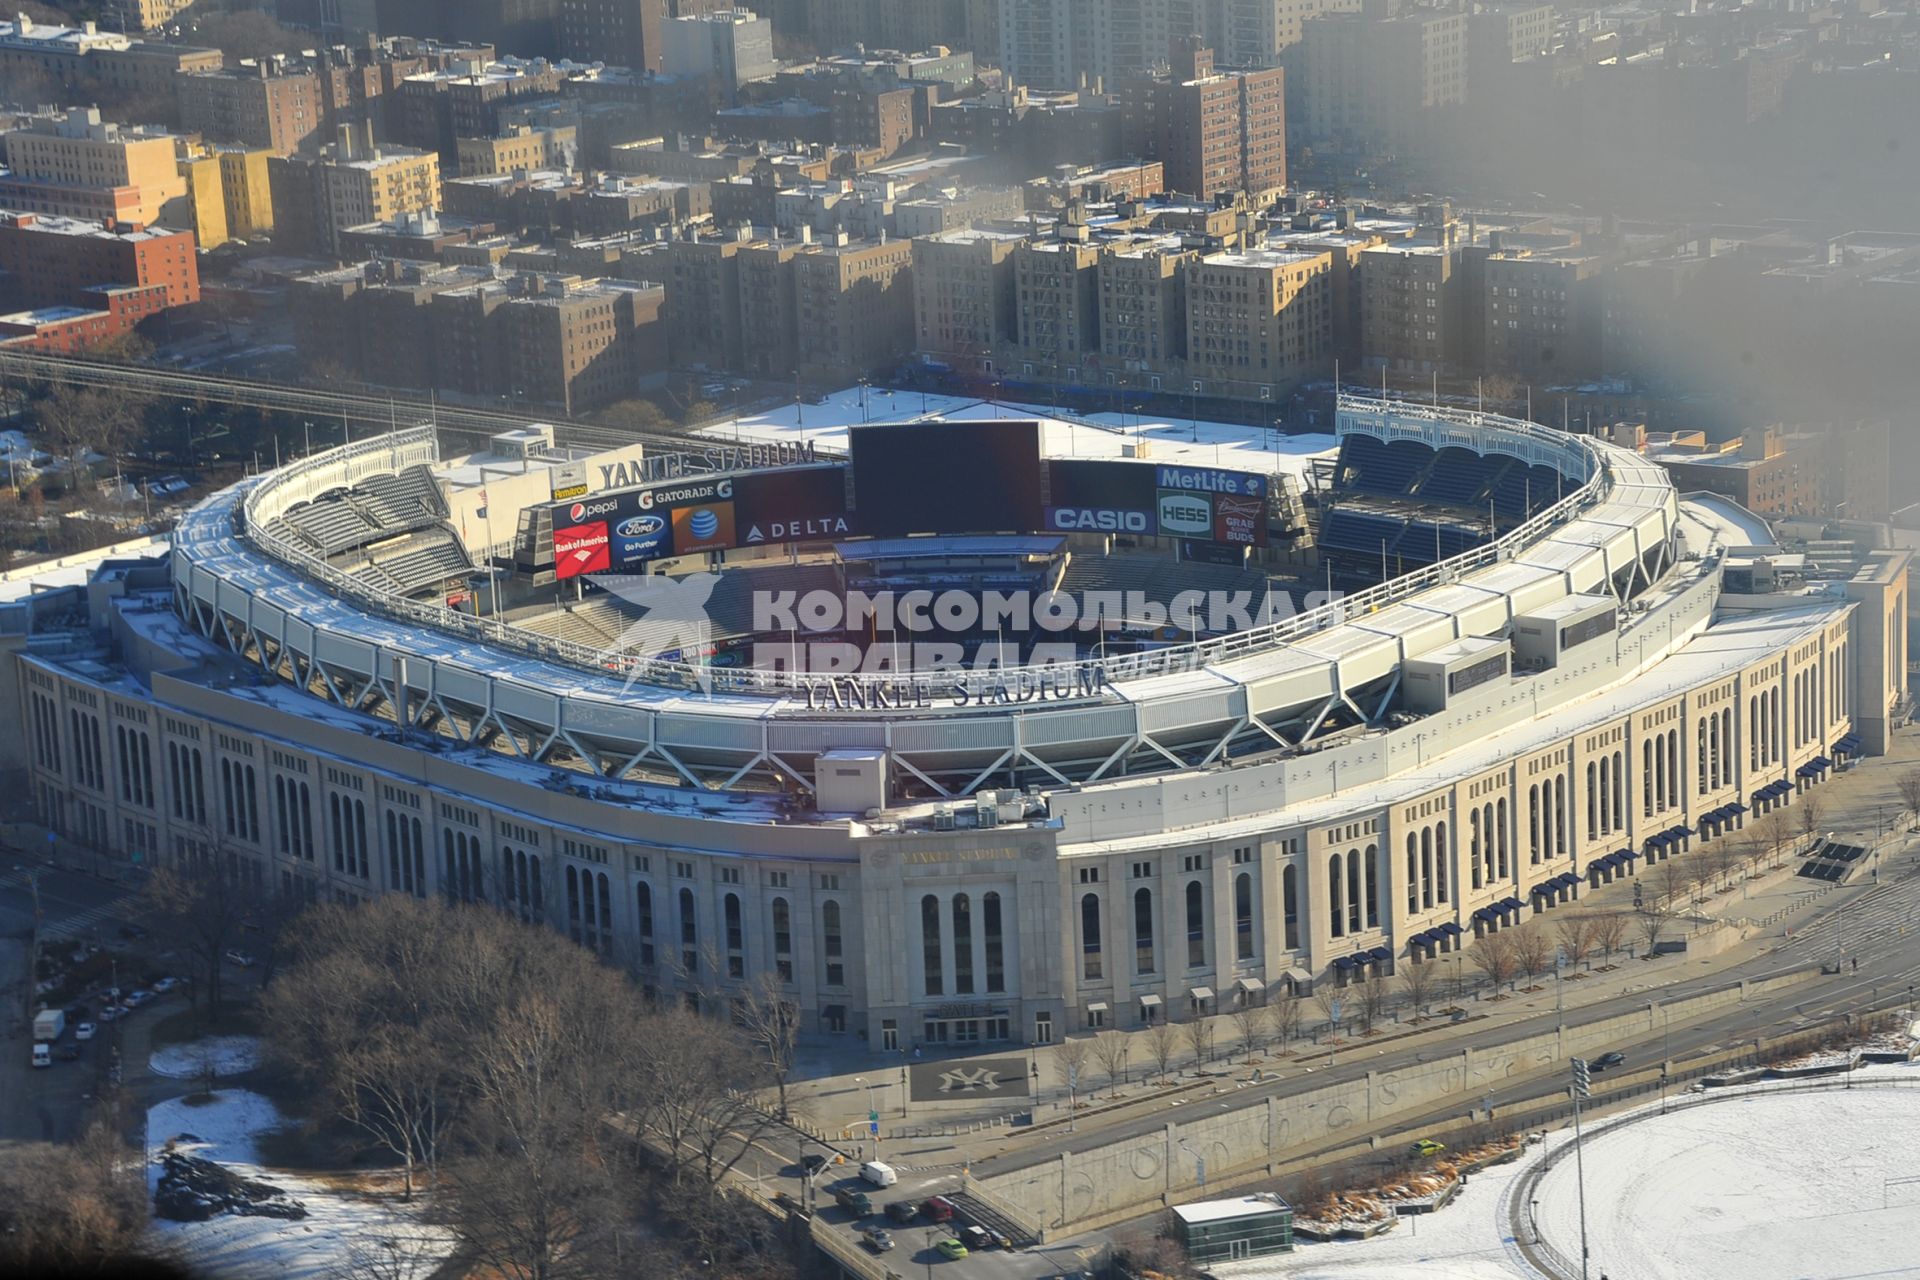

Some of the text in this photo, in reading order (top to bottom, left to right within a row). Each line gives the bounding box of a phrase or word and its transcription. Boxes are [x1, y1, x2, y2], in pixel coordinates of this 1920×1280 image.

[598, 439, 816, 490] YANKEE STADIUM
[1162, 469, 1237, 493] MetLife
[554, 485, 587, 500] Armitron
[656, 486, 714, 503] GATORADE
[587, 499, 618, 517] pepsi
[1163, 505, 1208, 523] HESS
[625, 519, 655, 535] Ford
[771, 518, 848, 538] DELTA
[1054, 509, 1147, 532] CASIO
[1225, 517, 1255, 529] GRAB
[555, 535, 609, 553] Bank of America
[624, 540, 658, 552] Go Further
[1226, 531, 1255, 543] BUDS
[683, 646, 697, 658] ZOO
[797, 665, 1106, 709] YANKEE STADIUM
